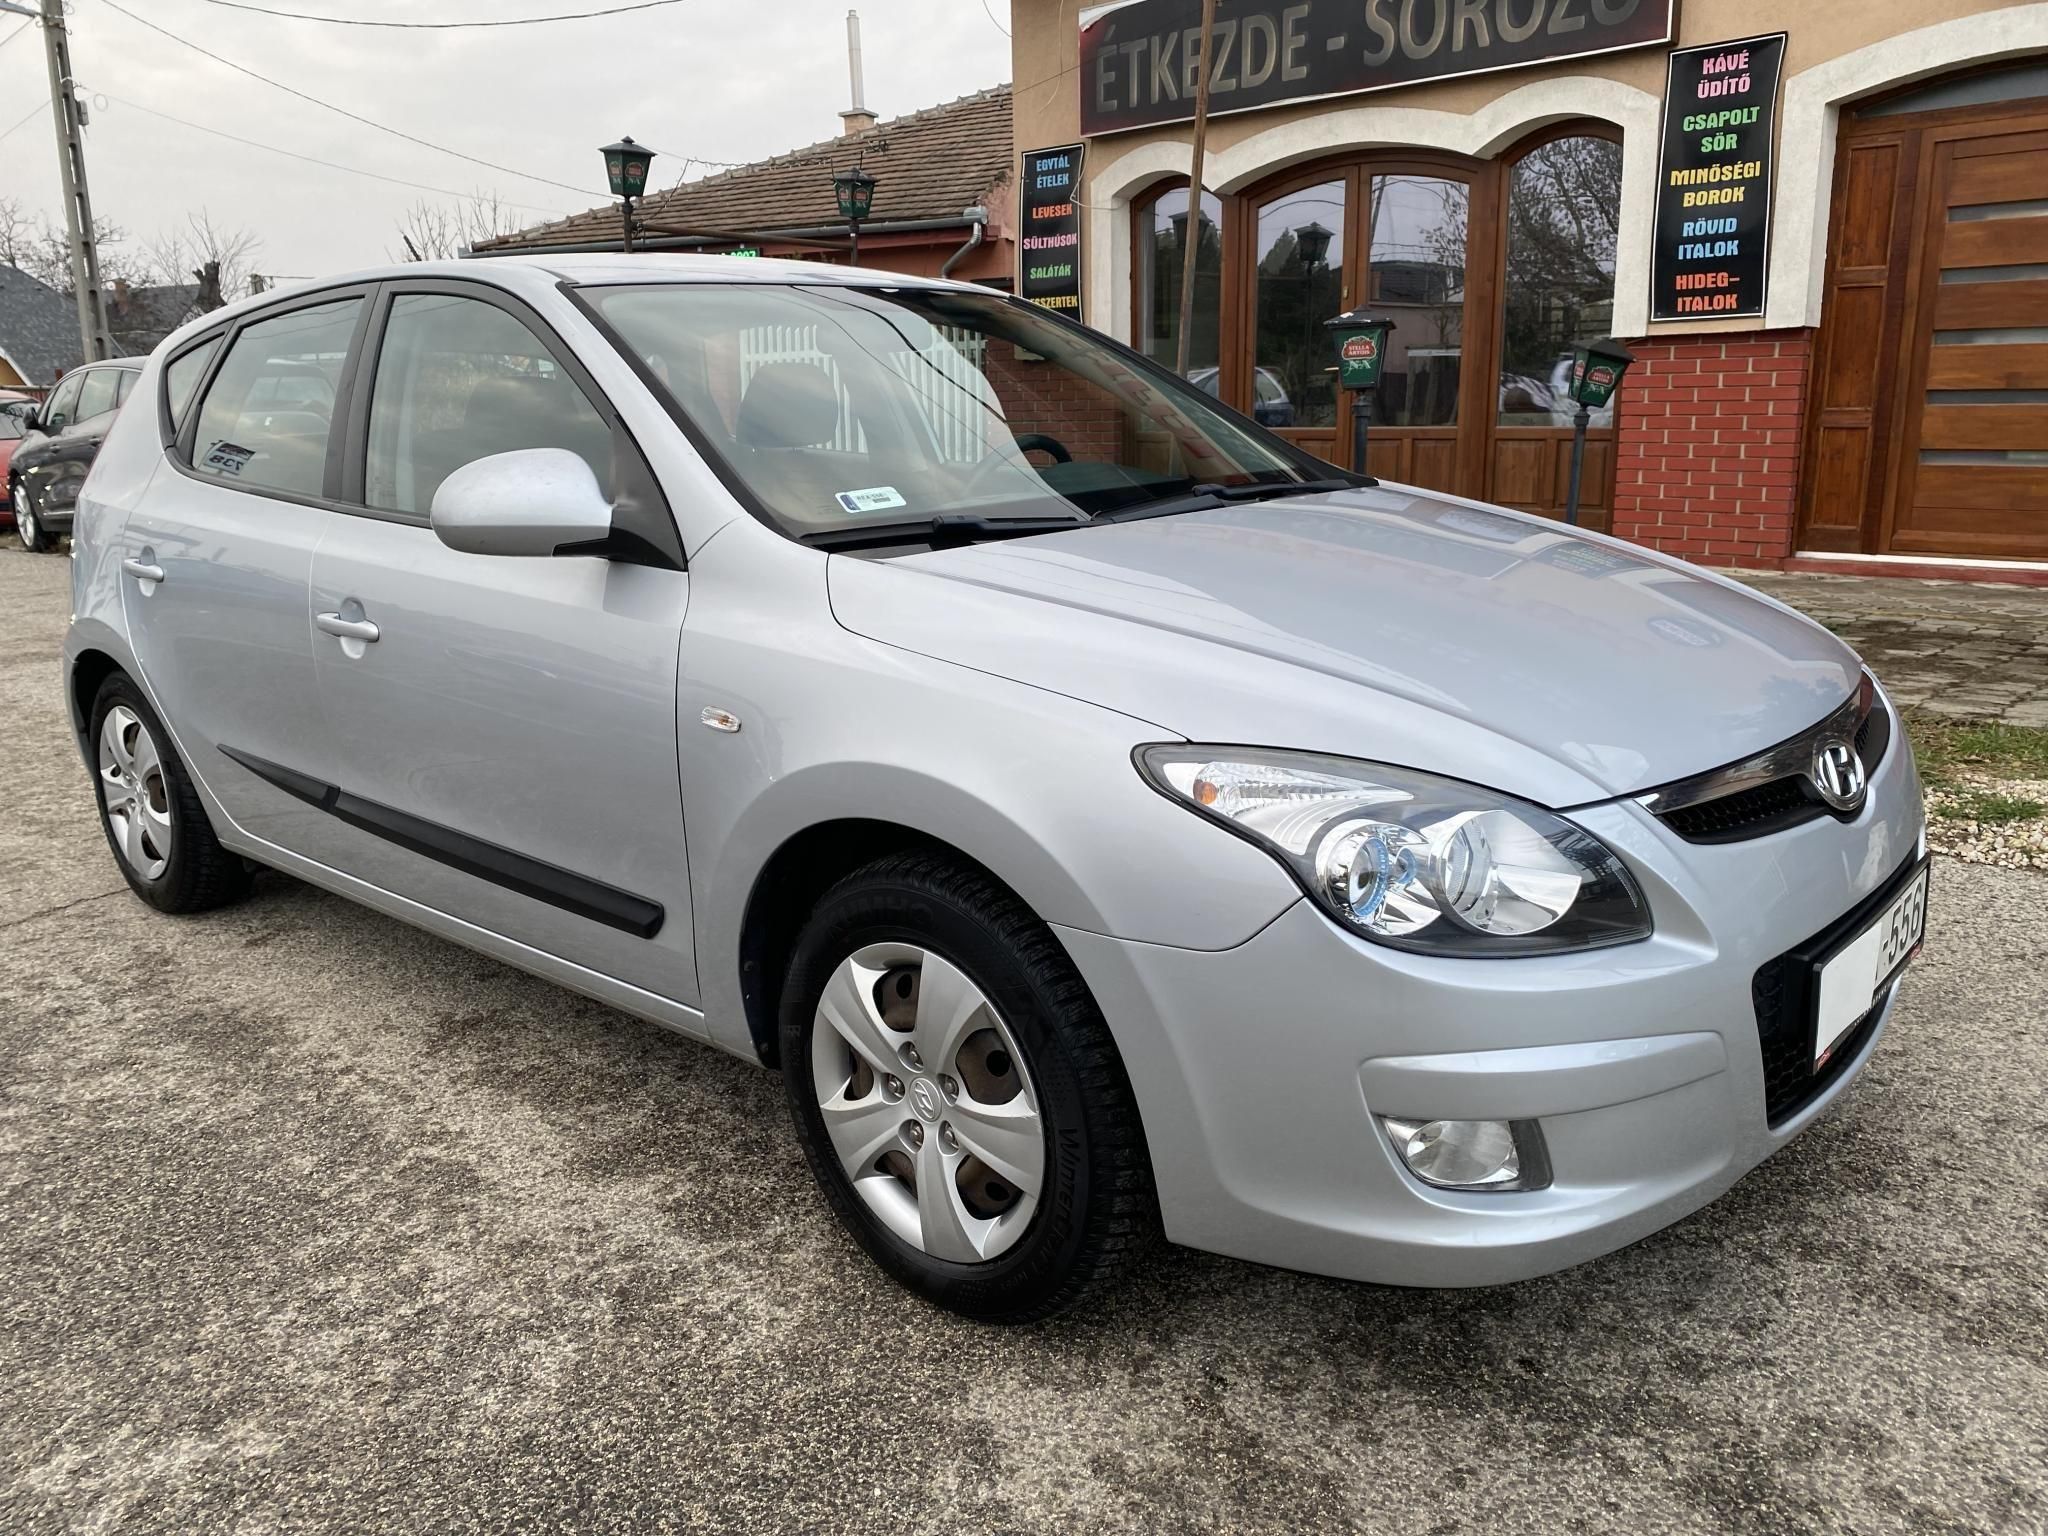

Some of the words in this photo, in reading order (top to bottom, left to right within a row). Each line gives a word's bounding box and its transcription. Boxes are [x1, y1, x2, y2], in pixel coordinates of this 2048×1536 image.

[1096, 4, 1310, 113] ÉTKEZDE
[1702, 49, 1750, 75] KÁVÉ
[1697, 73, 1751, 99] ÜDÍTŐ
[1682, 106, 1761, 132] CSAPOLT
[1700, 132, 1738, 153] SÖR
[1036, 155, 1070, 172] EGYTÁL
[1670, 161, 1761, 186] MINŐSÉGI
[1036, 173, 1069, 189] ÉTELEK
[1682, 186, 1746, 208] BOROK
[1032, 203, 1073, 219] LEVESEK
[1682, 217, 1738, 237] RÖVID
[1023, 232, 1077, 250] SÜLTHÚSOK
[1678, 239, 1739, 260] ITALOK
[1029, 264, 1072, 280] SALÁTÁK
[1675, 271, 1740, 290] HIDEG-
[1677, 293, 1738, 313] ITALOK
